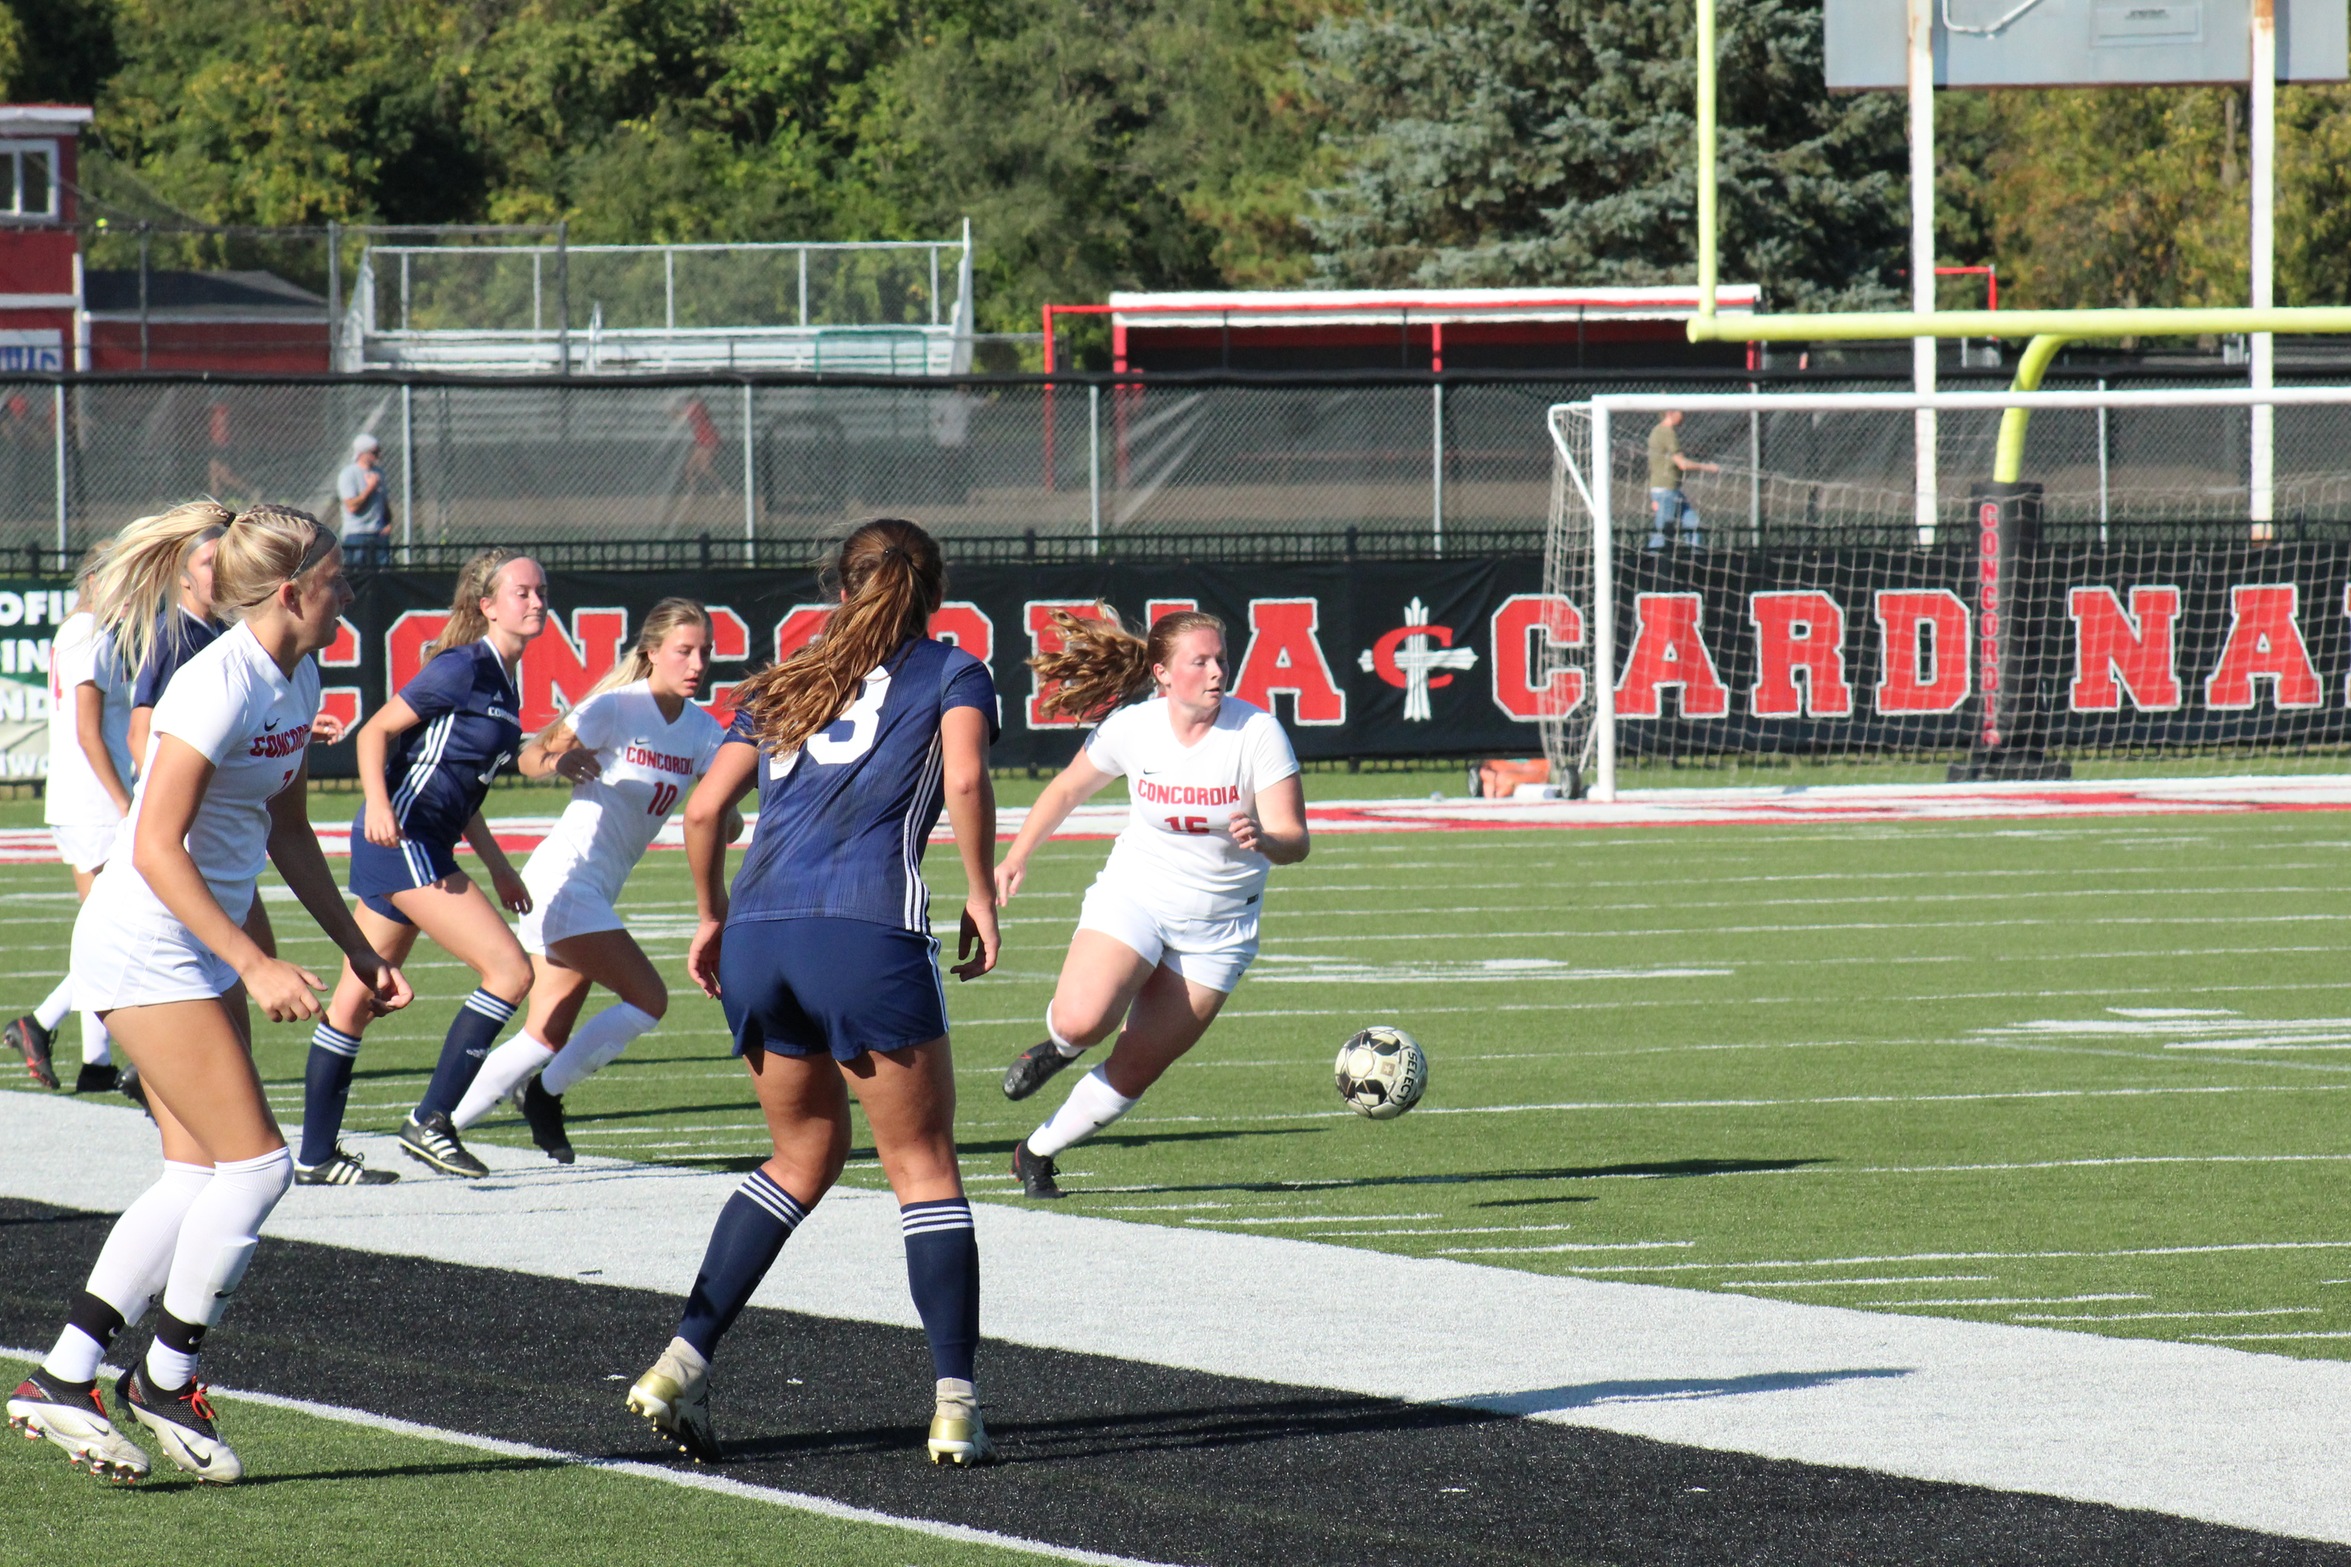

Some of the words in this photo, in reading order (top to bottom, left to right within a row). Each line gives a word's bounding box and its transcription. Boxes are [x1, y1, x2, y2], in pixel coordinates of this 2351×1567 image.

[1490, 583, 2351, 723] CARDNA
[769, 665, 892, 781] 3
[647, 781, 678, 817] 10
[1137, 778, 1241, 806] CONCORDIA
[1396, 1050, 1418, 1101] SELECT
